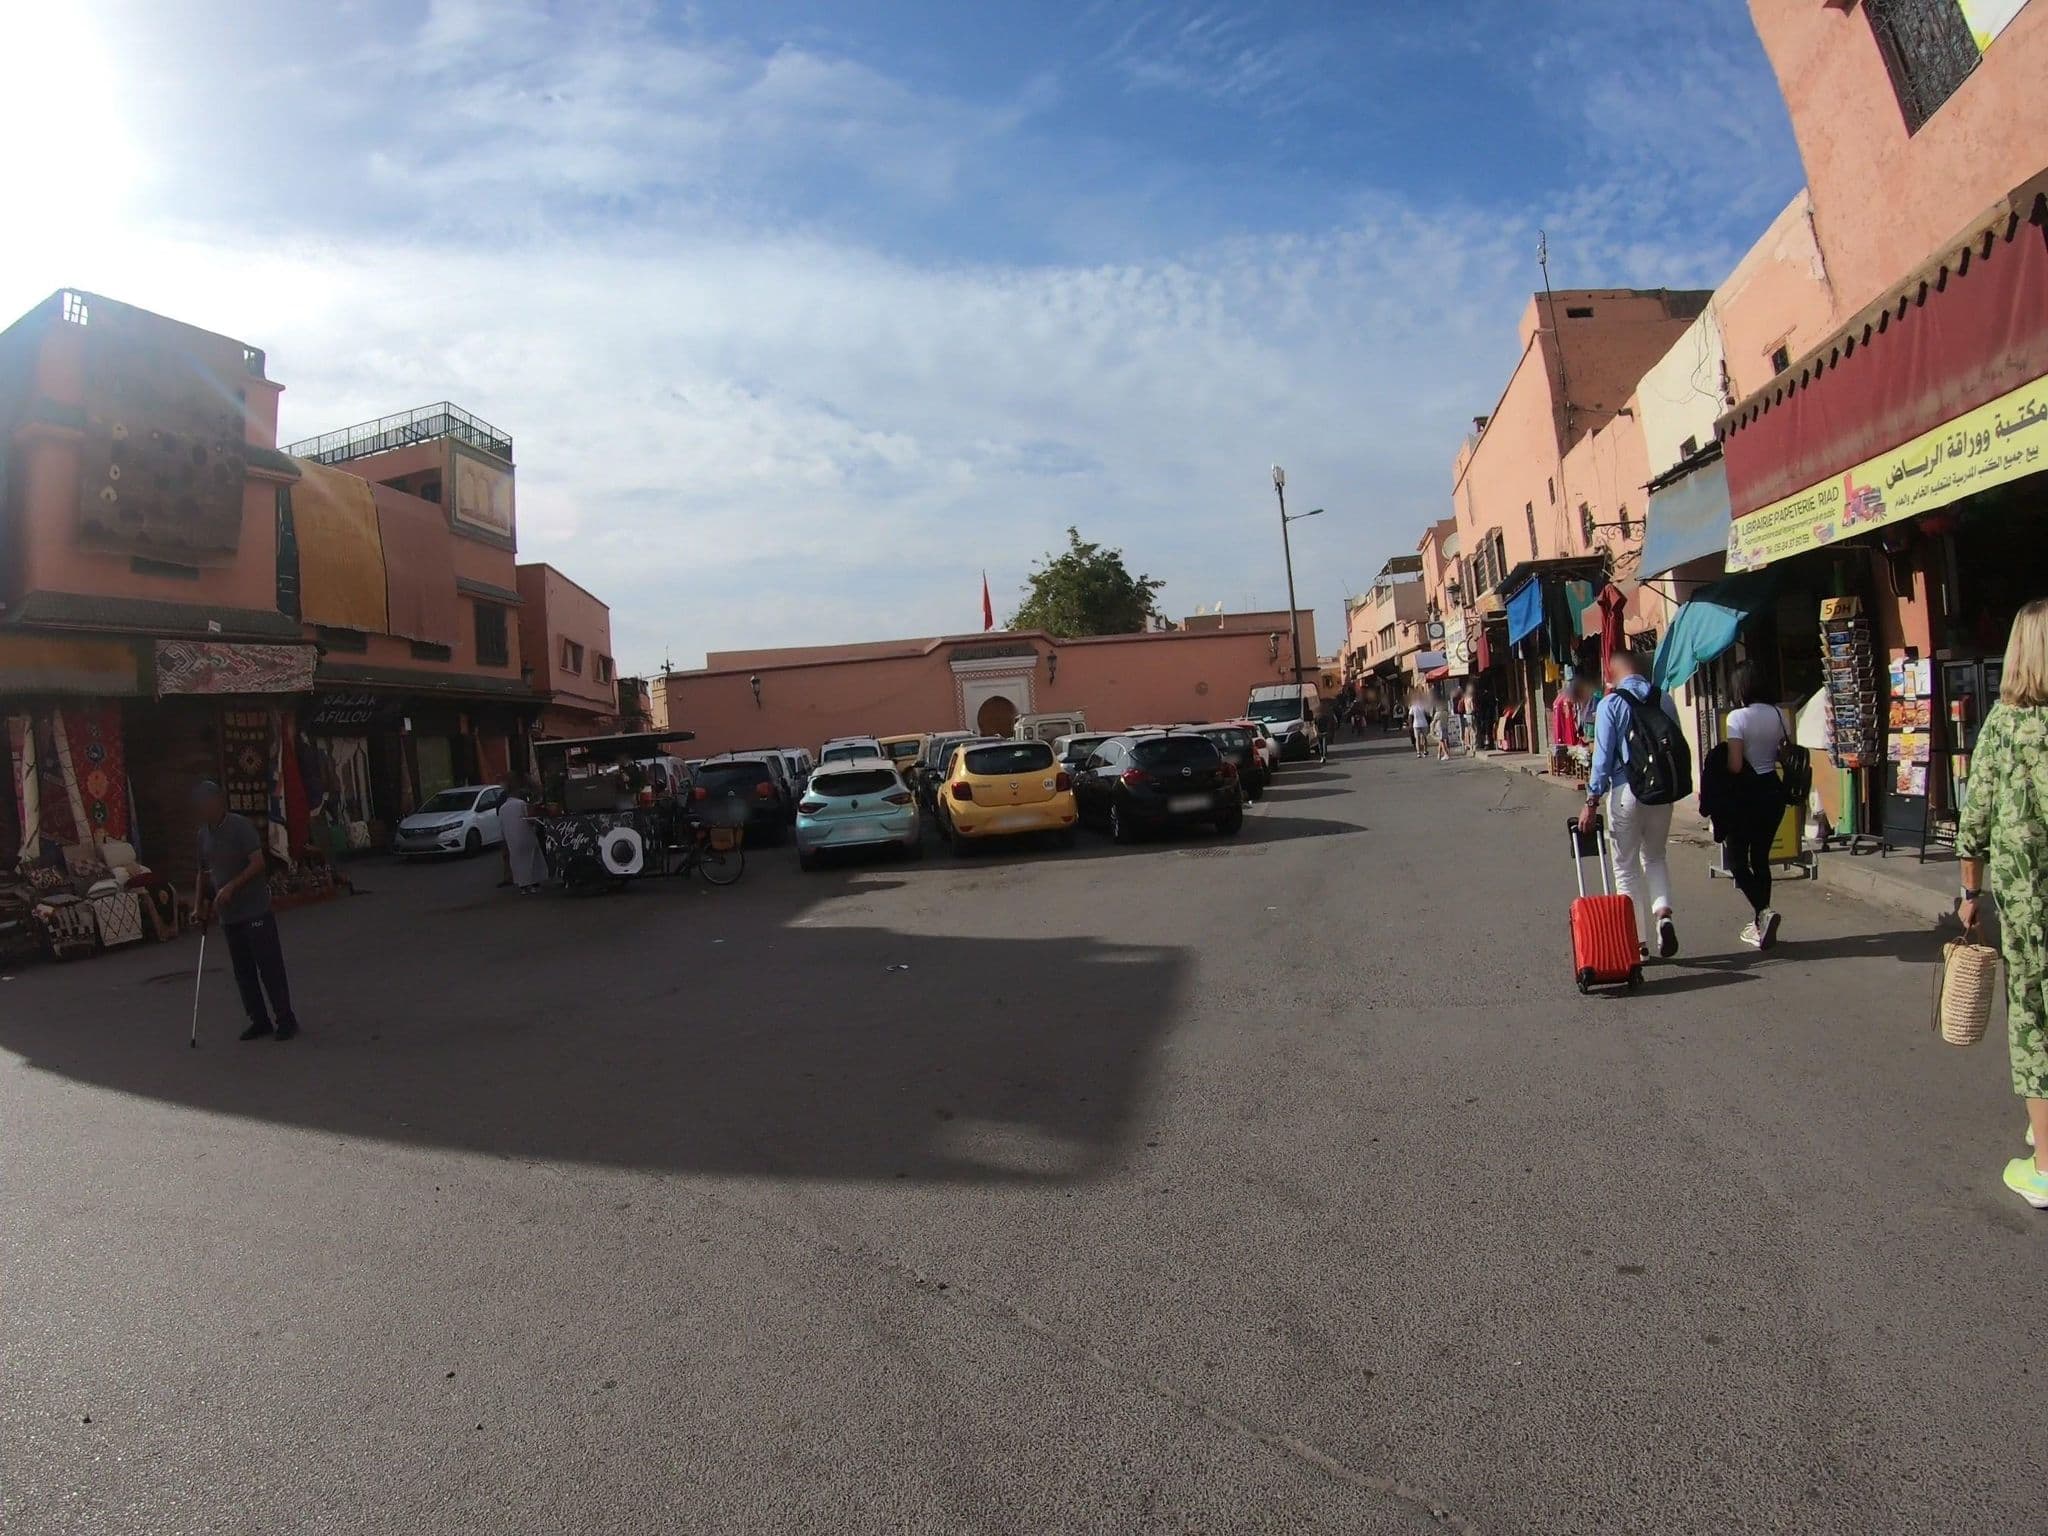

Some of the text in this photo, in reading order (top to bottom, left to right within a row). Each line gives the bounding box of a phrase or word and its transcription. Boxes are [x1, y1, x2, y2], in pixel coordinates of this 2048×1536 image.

[1947, 429, 1990, 459] ووراقة
[1885, 442, 1943, 489] الرياض
[1773, 496, 1816, 525] PAPETERIE
[1818, 486, 1840, 507] RIAD
[556, 821, 579, 835] Hot
